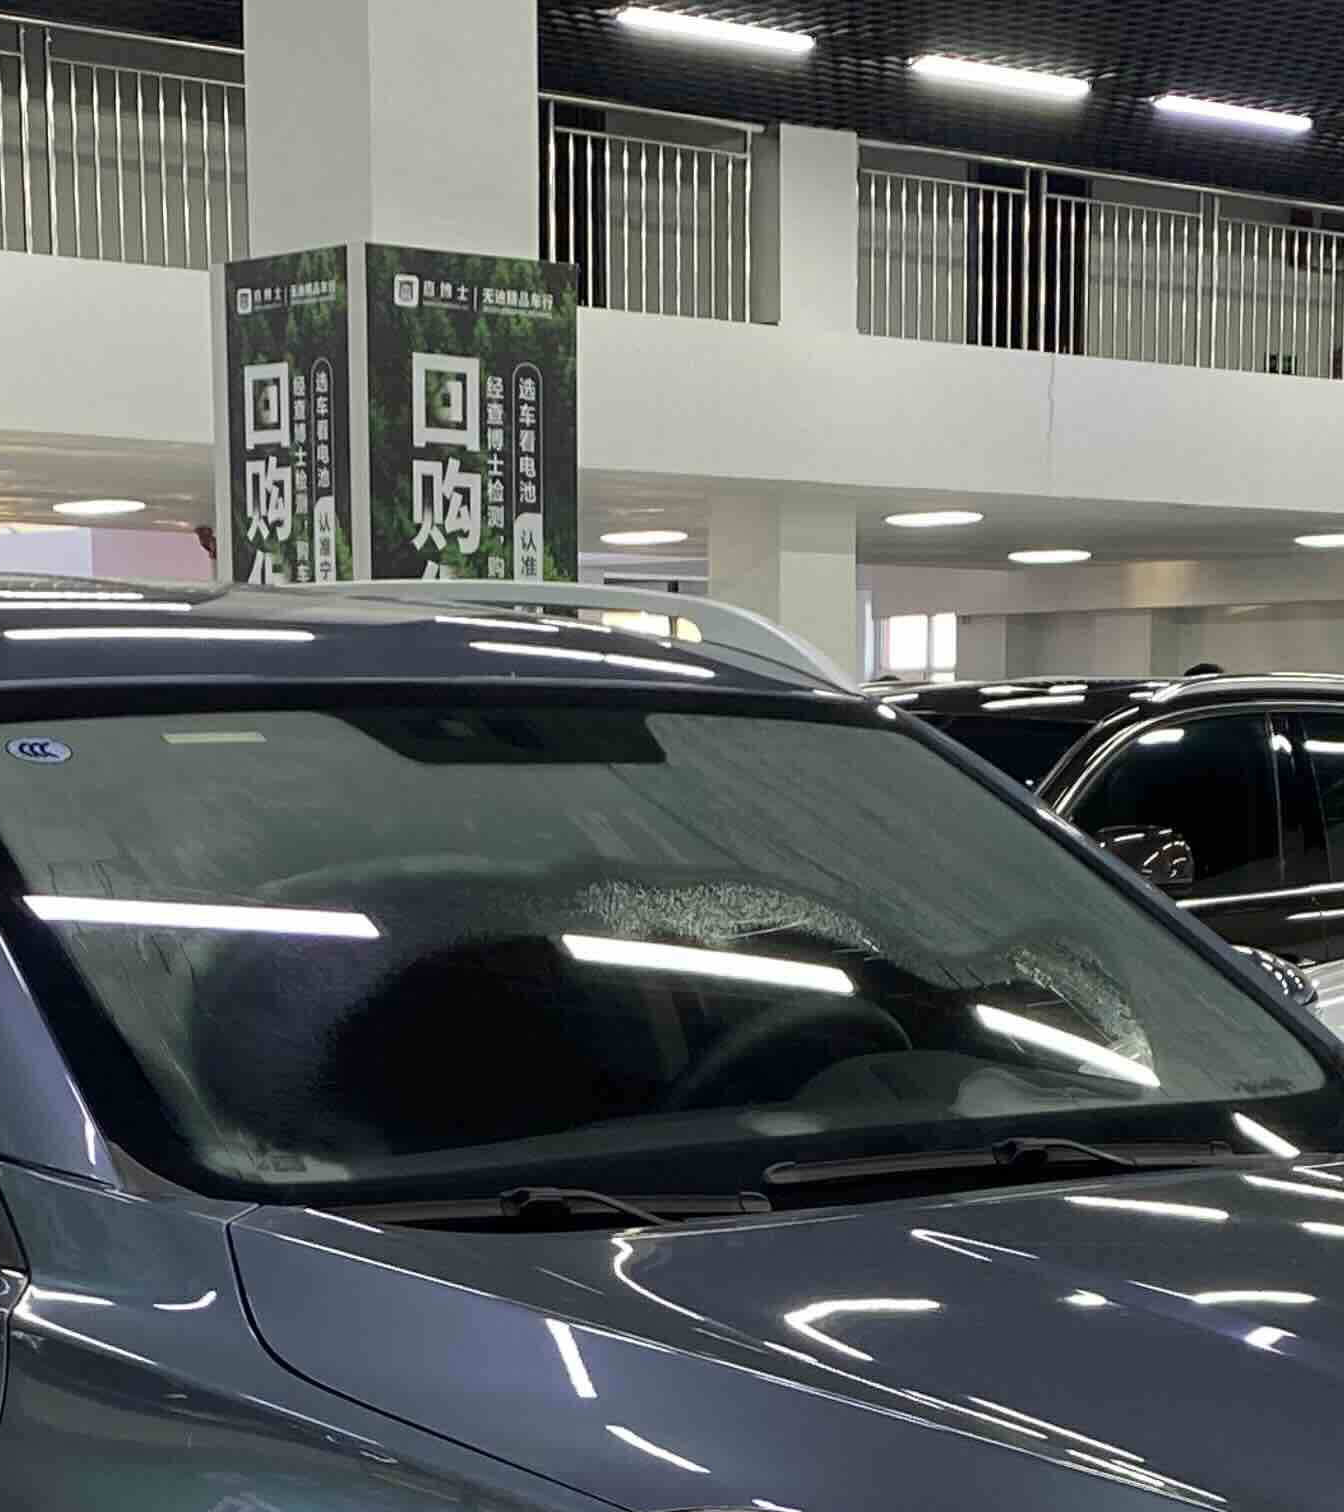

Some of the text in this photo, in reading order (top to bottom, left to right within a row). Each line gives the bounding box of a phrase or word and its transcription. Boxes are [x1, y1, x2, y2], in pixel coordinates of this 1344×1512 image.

[243, 361, 293, 583] 回购
[411, 351, 482, 580] 回购
[518, 376, 538, 505] 选车看电池
[519, 529, 538, 578] 认准
